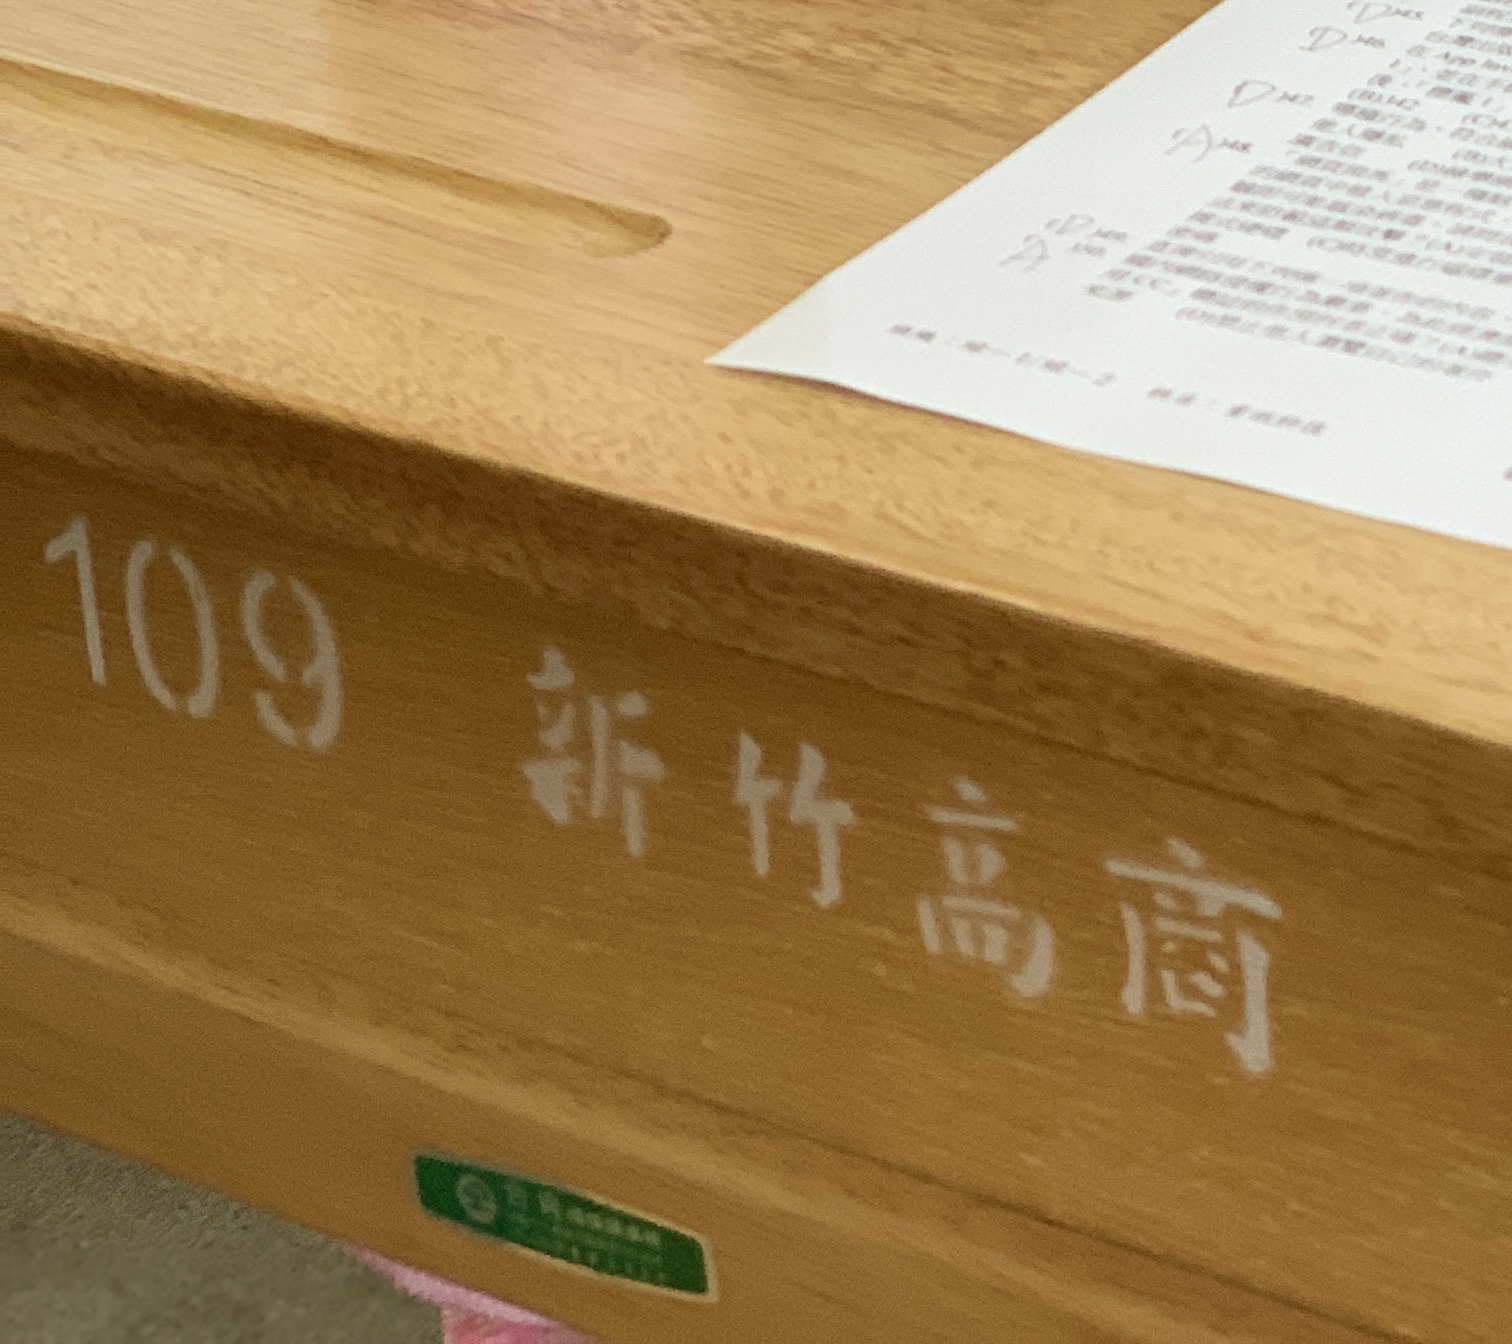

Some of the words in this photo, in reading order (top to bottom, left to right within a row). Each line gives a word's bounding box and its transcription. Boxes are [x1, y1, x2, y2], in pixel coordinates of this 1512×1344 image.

[44, 518, 343, 754] 109
[522, 647, 1281, 1077] 新竹高商
